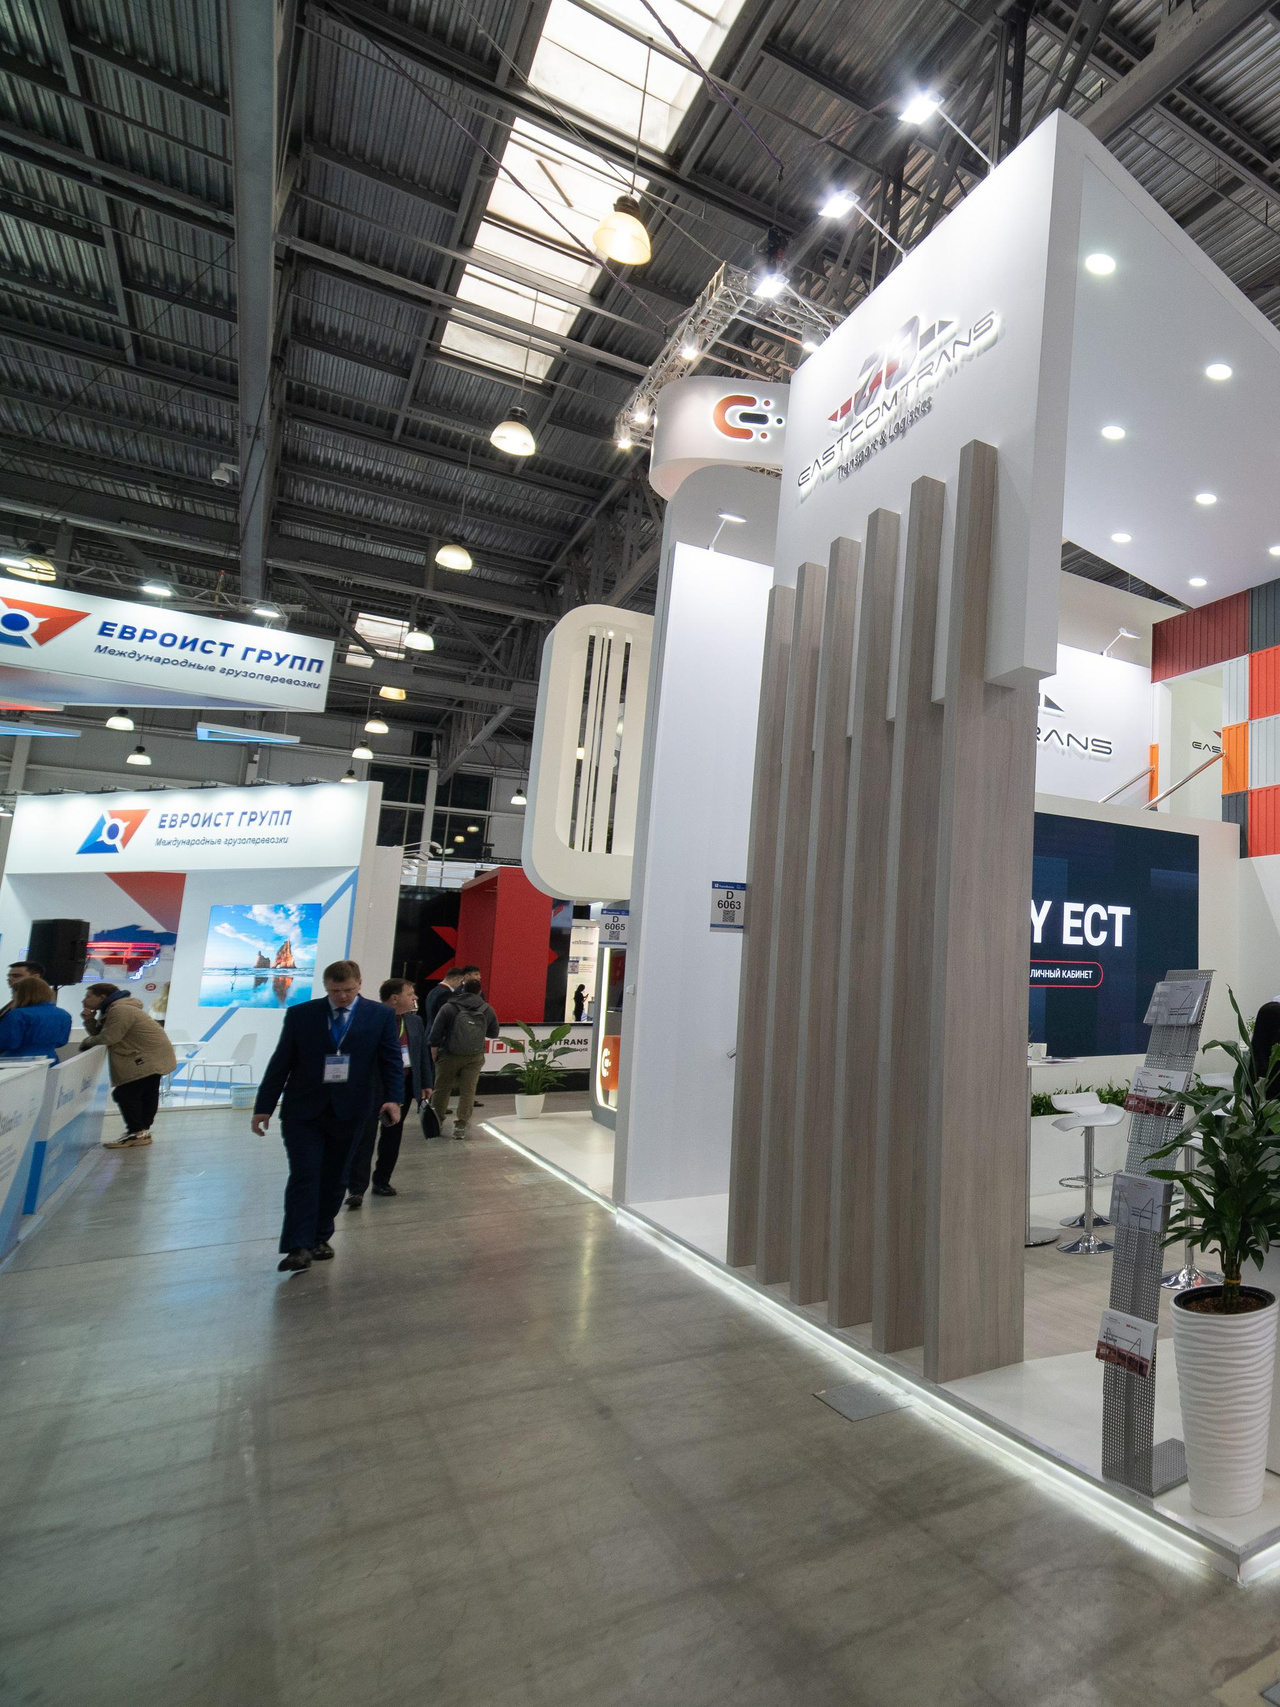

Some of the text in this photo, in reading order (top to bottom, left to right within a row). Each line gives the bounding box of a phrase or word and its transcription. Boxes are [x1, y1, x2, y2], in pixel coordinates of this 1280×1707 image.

[798, 310, 994, 487] EASTCOMTRANS
[837, 396, 933, 480] Transport & Logistics
[97, 621, 324, 674] ЕВРОИСТ ГРУПП
[94, 645, 321, 690] Международные грузоперевозки
[1192, 741, 1221, 754] EAS
[158, 809, 292, 829] ЕВРОИСТ ГРУПП
[155, 836, 289, 848] Международные грузоперевозки
[726, 890, 734, 900] D
[717, 899, 742, 910] 6063
[612, 915, 619, 923] D
[1031, 899, 1131, 948] Y ECT
[604, 922, 626, 931] 6065
[1030, 968, 1093, 979] ЛИЧНЫЙ КАБИНЕТ
